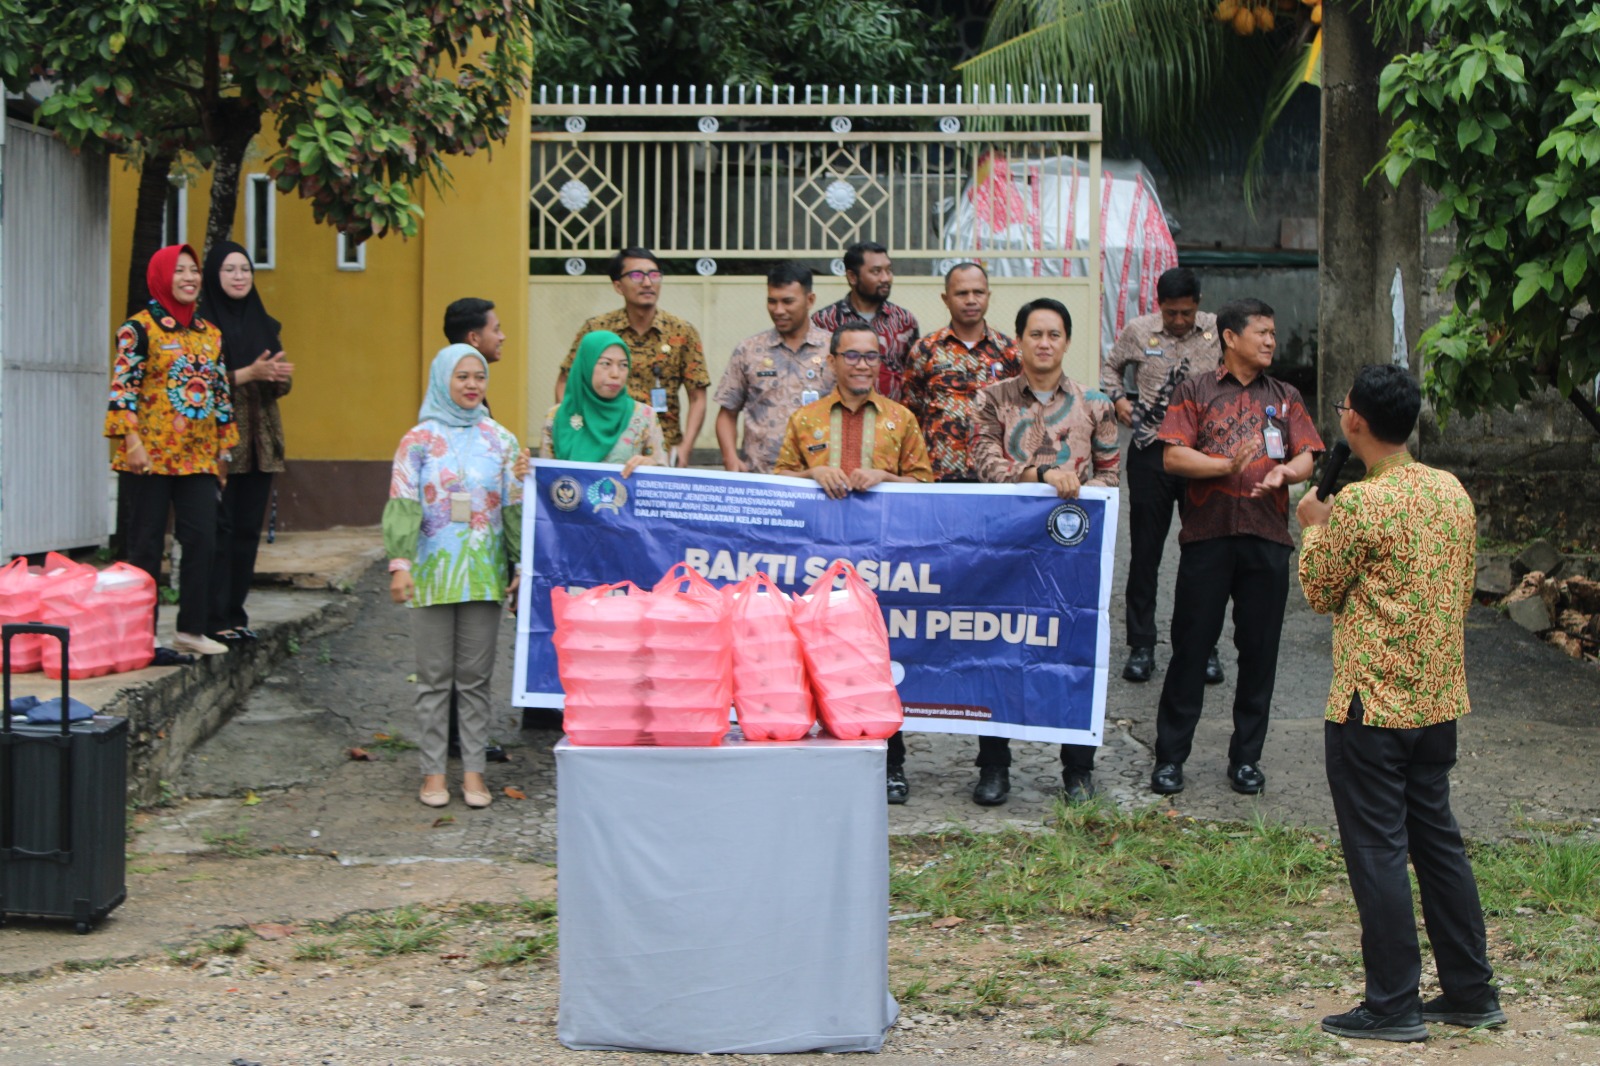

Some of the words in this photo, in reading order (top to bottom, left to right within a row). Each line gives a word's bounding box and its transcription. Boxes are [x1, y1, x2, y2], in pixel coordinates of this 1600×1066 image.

[636, 480, 691, 491] KEMENTERIAN
[692, 484, 727, 494] IMIGRASI
[728, 486, 745, 495] DAN
[746, 488, 816, 500] PEMASYARAKATAN
[817, 493, 826, 501] RI
[636, 489, 683, 500] DIREKTORAT
[684, 492, 723, 503] JENDERAL
[725, 495, 795, 508] PEMASYARAKATAN
[634, 508, 659, 518] BALAI
[660, 511, 735, 523] PEMASYARAKATAN
[736, 515, 763, 525] KELAS
[763, 517, 770, 526] II
[771, 518, 805, 528] BAUBAU
[635, 499, 667, 509] KANTOR
[668, 501, 701, 512] WILAYAH
[702, 504, 741, 514] SULAWESI
[742, 506, 783, 517] TENGGARA
[684, 548, 797, 585] BAKTI
[802, 556, 941, 594] SOSIAL
[926, 610, 1060, 647] PEDULI
[905, 707, 965, 717] Pemasyarakatan
[965, 709, 993, 719] Baubau
